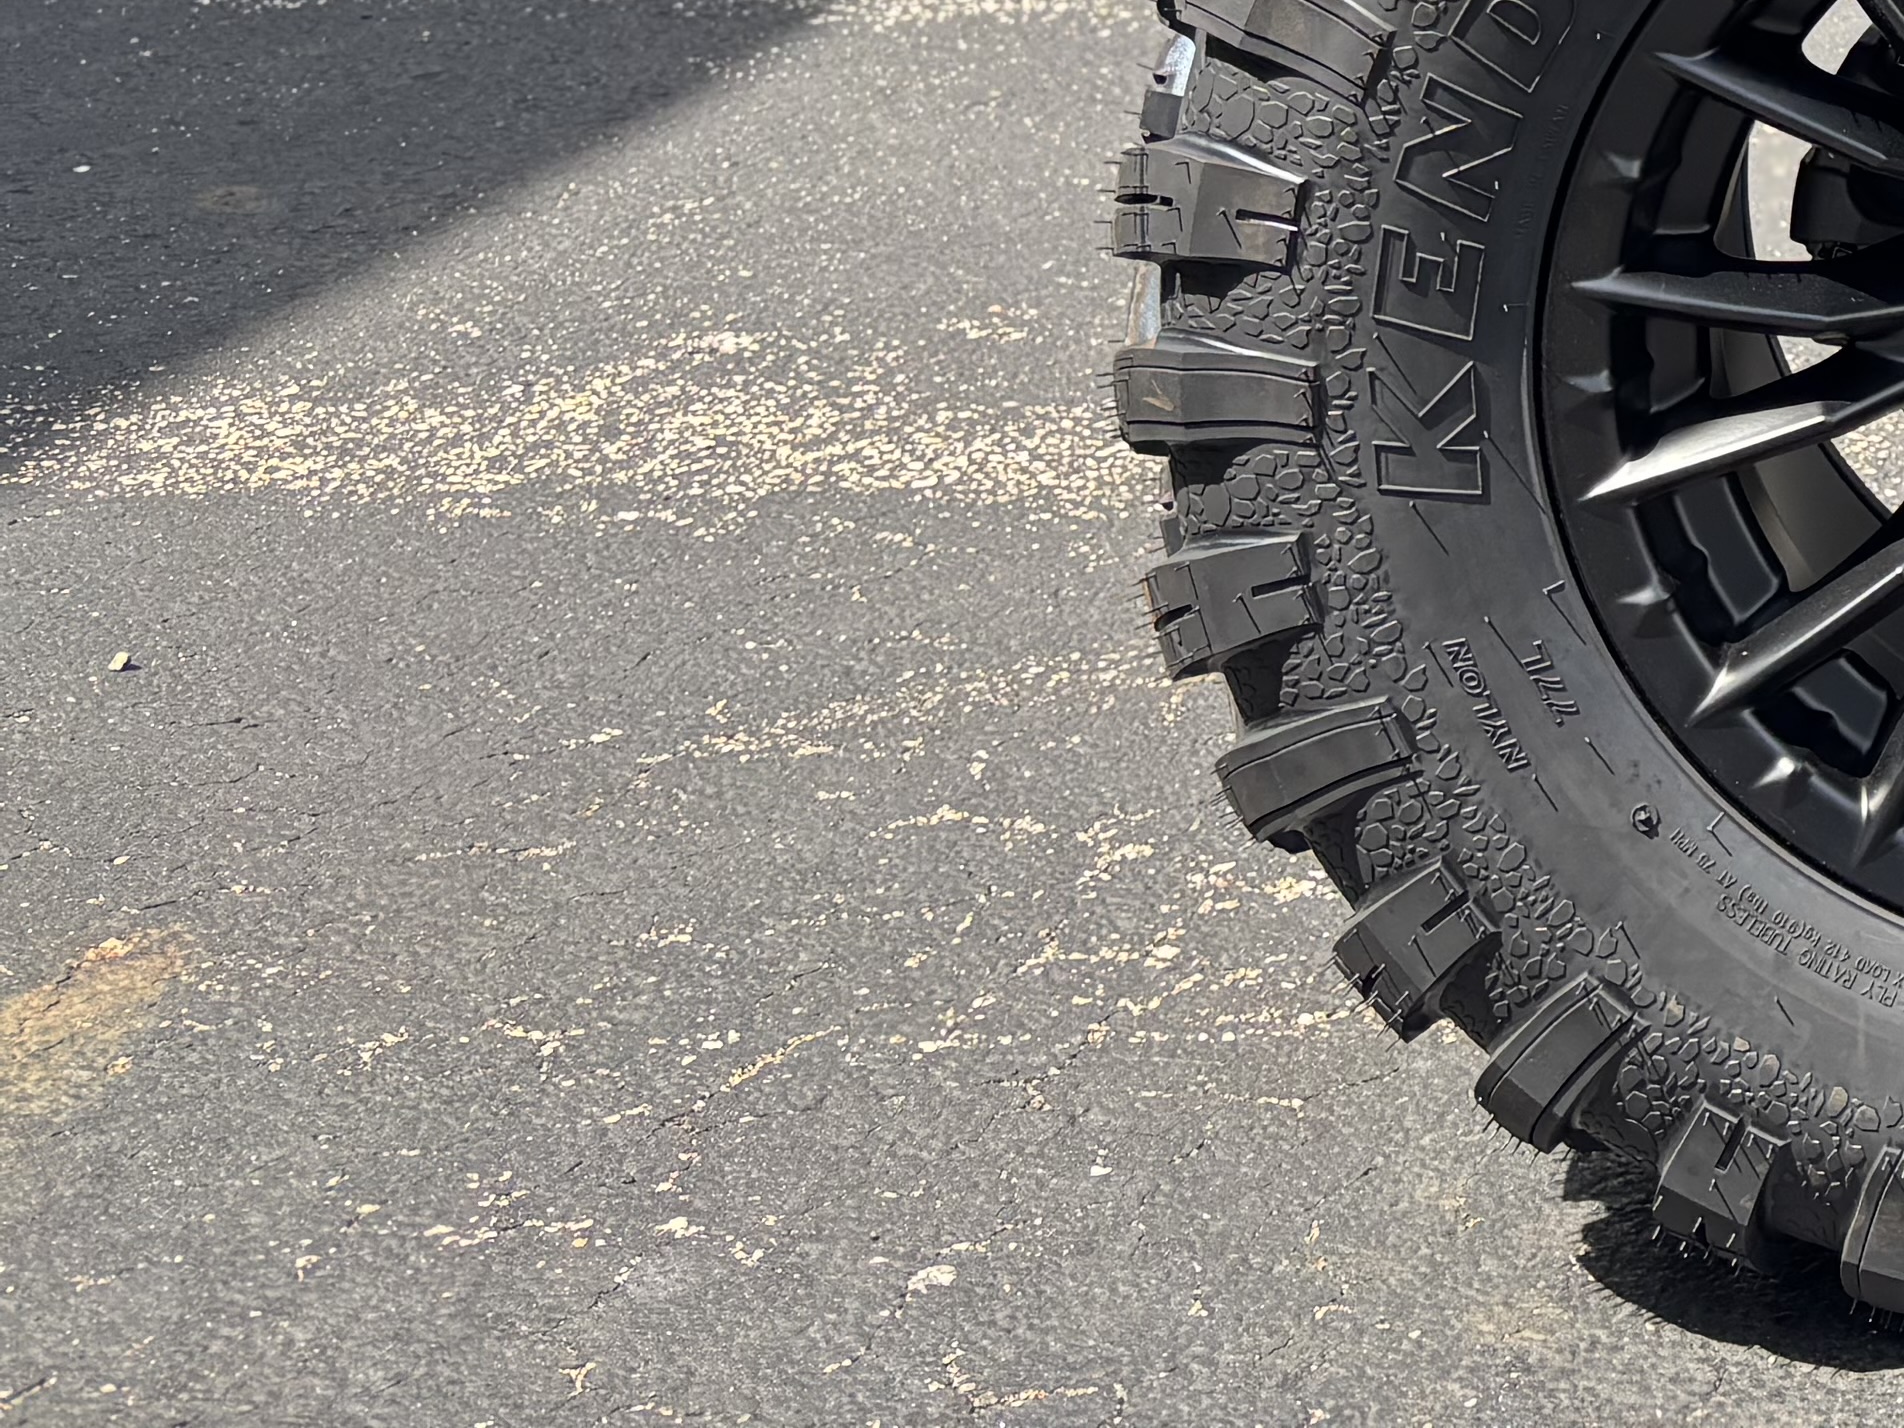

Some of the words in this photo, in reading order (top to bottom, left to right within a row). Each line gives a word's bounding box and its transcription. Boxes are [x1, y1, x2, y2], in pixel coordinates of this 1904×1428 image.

[1443, 637, 1530, 771] NYLON
[1521, 640, 1579, 726] 77L
[1716, 869, 1739, 890] AT
[1716, 894, 1793, 956] TUBELESS
[1798, 947, 1858, 991] RATING
[1855, 956, 1891, 984] LOAD
